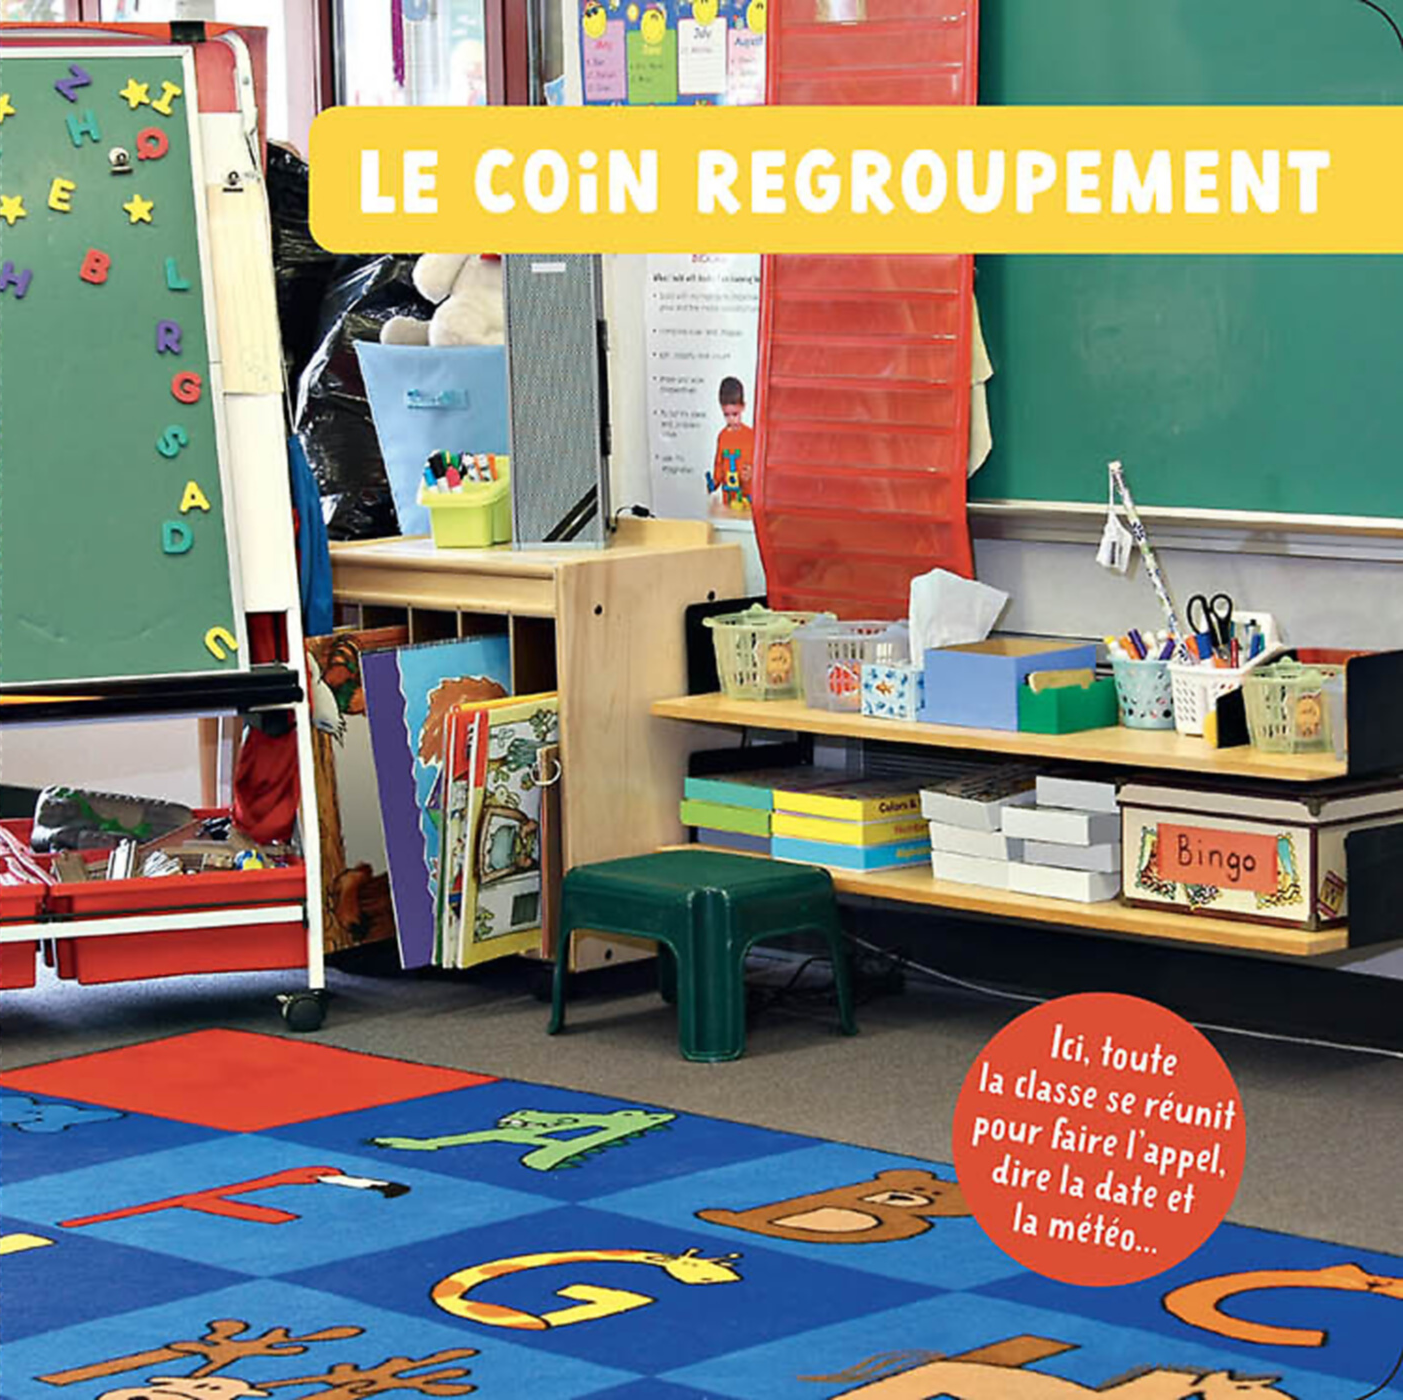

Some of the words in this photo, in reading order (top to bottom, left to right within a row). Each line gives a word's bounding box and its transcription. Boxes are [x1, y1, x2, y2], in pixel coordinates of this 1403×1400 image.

[65, 109, 101, 148] H
[48, 178, 77, 212] E
[80, 247, 112, 284] B
[162, 257, 193, 292] L
[155, 320, 183, 354] R
[171, 371, 203, 404] G
[154, 423, 191, 459] S
[179, 480, 211, 514] A
[160, 519, 195, 555] D
[878, 801, 908, 813] Colors
[1177, 834, 1257, 882] Bingo
